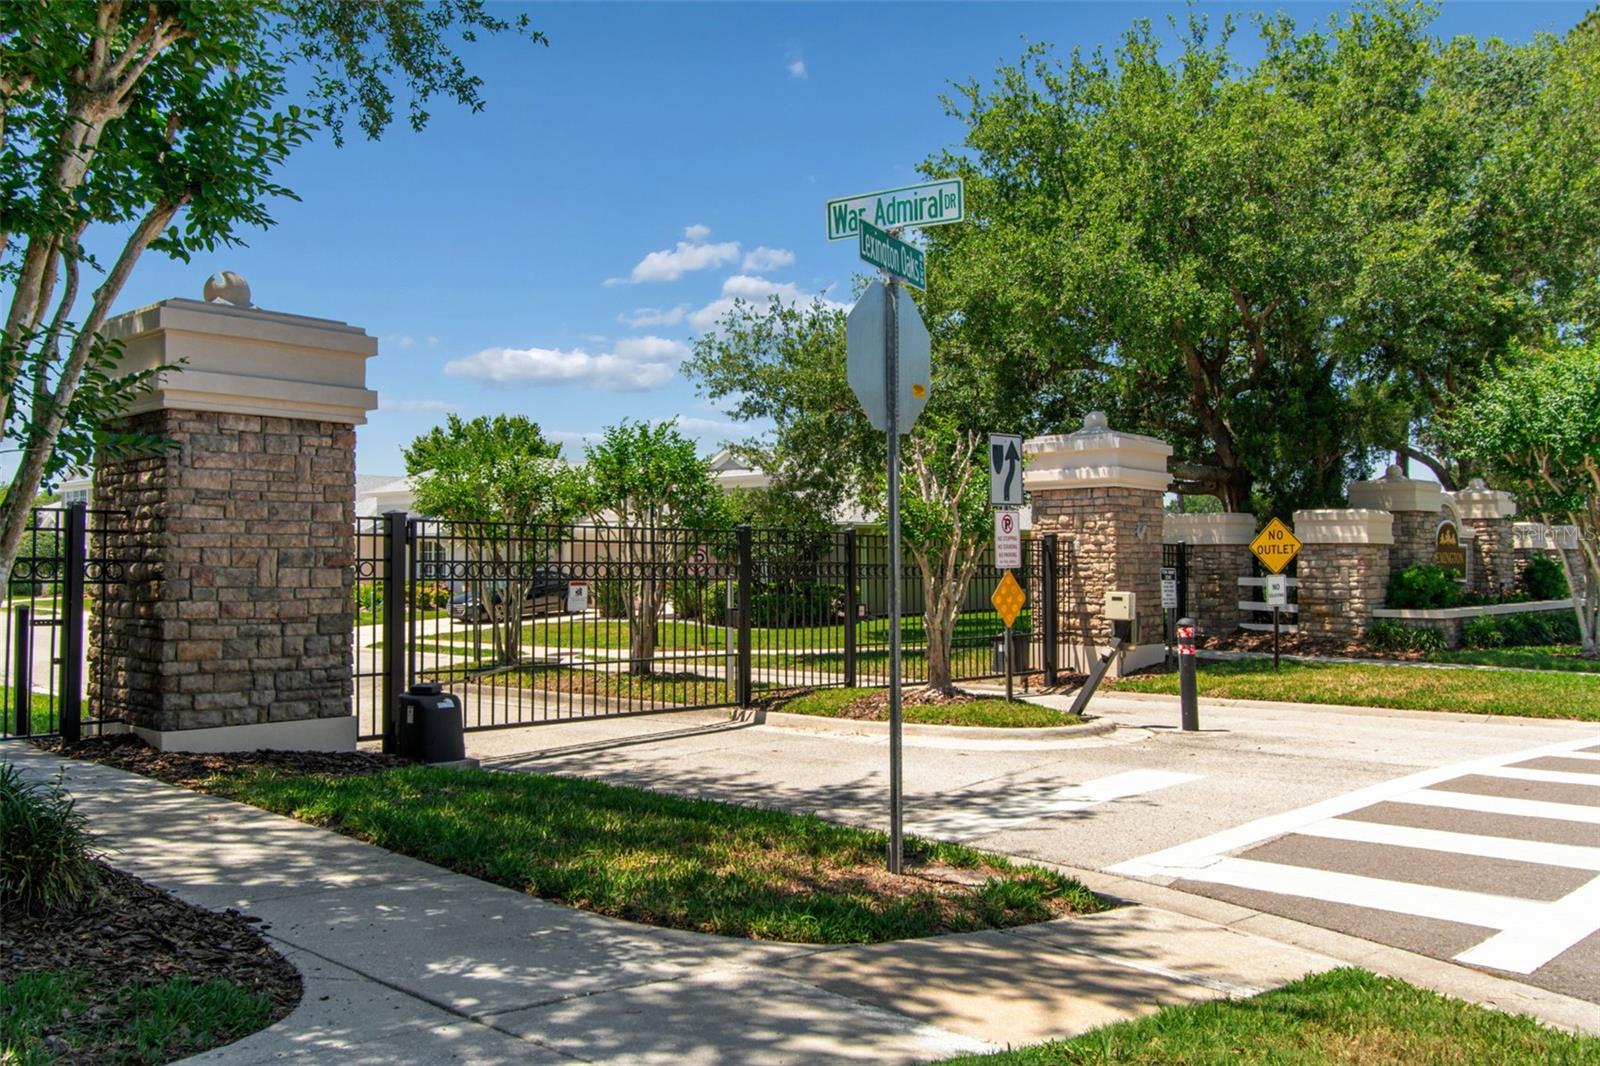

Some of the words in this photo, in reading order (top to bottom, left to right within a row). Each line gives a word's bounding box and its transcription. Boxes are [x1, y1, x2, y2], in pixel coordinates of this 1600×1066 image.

[832, 204, 866, 234] War
[874, 188, 944, 227] Admiral
[944, 193, 957, 210] DR
[860, 223, 900, 271] Lexington
[900, 243, 920, 281] Oaks
[1268, 530, 1284, 541] NO
[1257, 544, 1295, 555] OUTLET
[1272, 583, 1280, 591] NO
